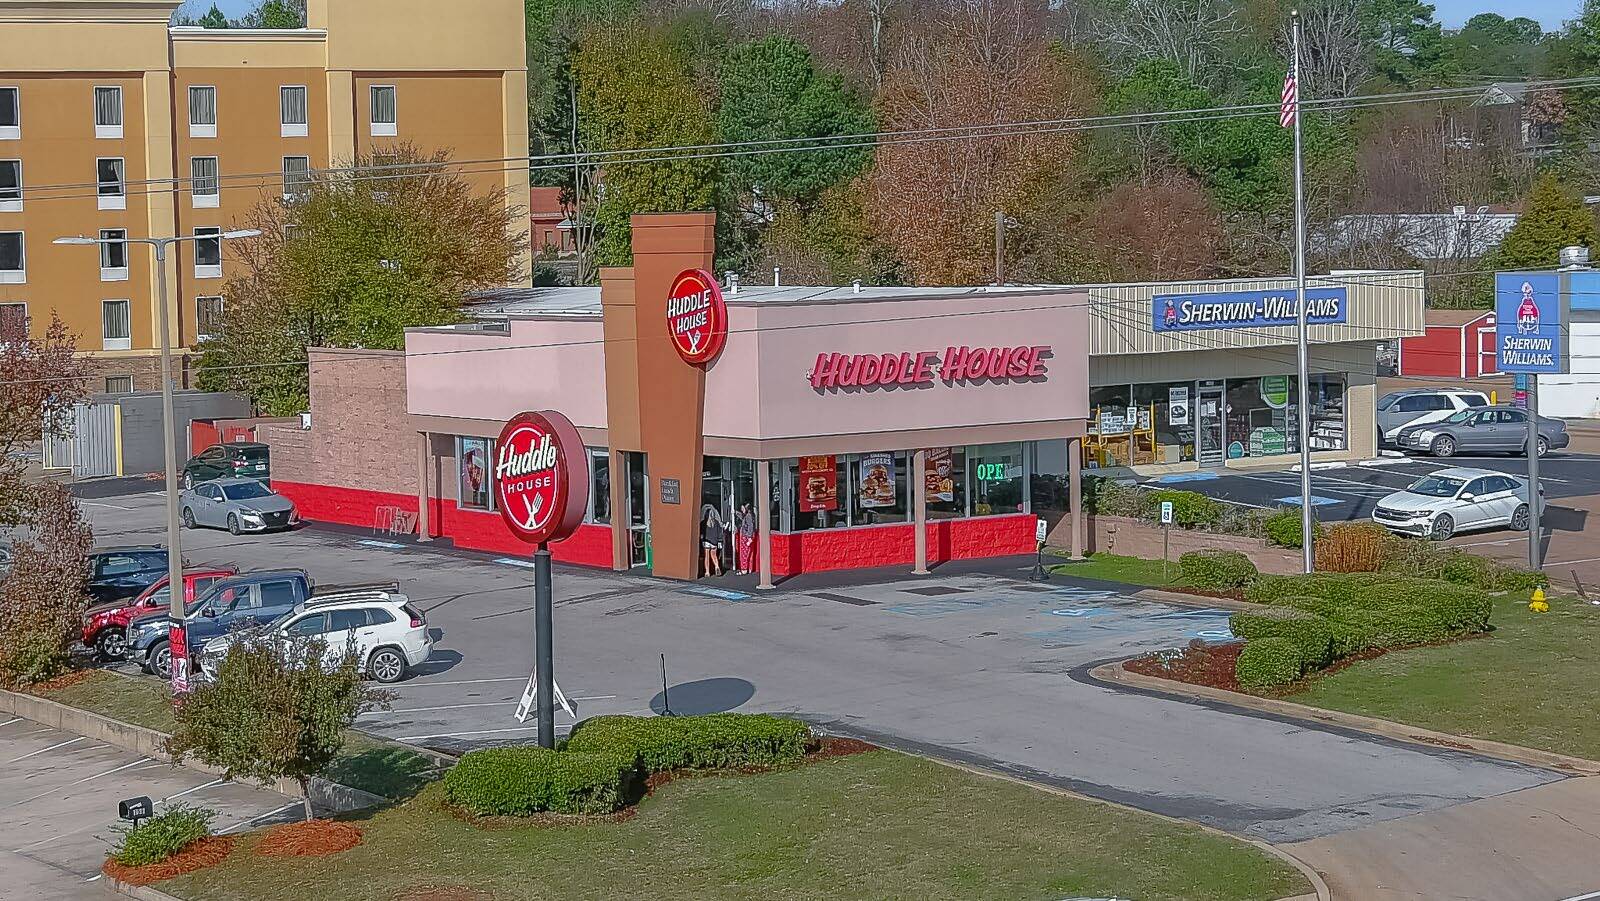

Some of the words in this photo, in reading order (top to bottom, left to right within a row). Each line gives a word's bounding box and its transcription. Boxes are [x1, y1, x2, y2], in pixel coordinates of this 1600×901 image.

[667, 289, 711, 319] HUDDLE
[1179, 296, 1339, 323] SHERWIN-WILLAMS
[676, 311, 707, 334] HOUSE
[1503, 336, 1552, 350] SHERWIN
[810, 351, 938, 388] HUDDLE
[939, 346, 1052, 381] HOUSE
[496, 434, 556, 480] Huddle
[862, 457, 891, 467] BURGERS
[507, 476, 551, 494] HOUSE
